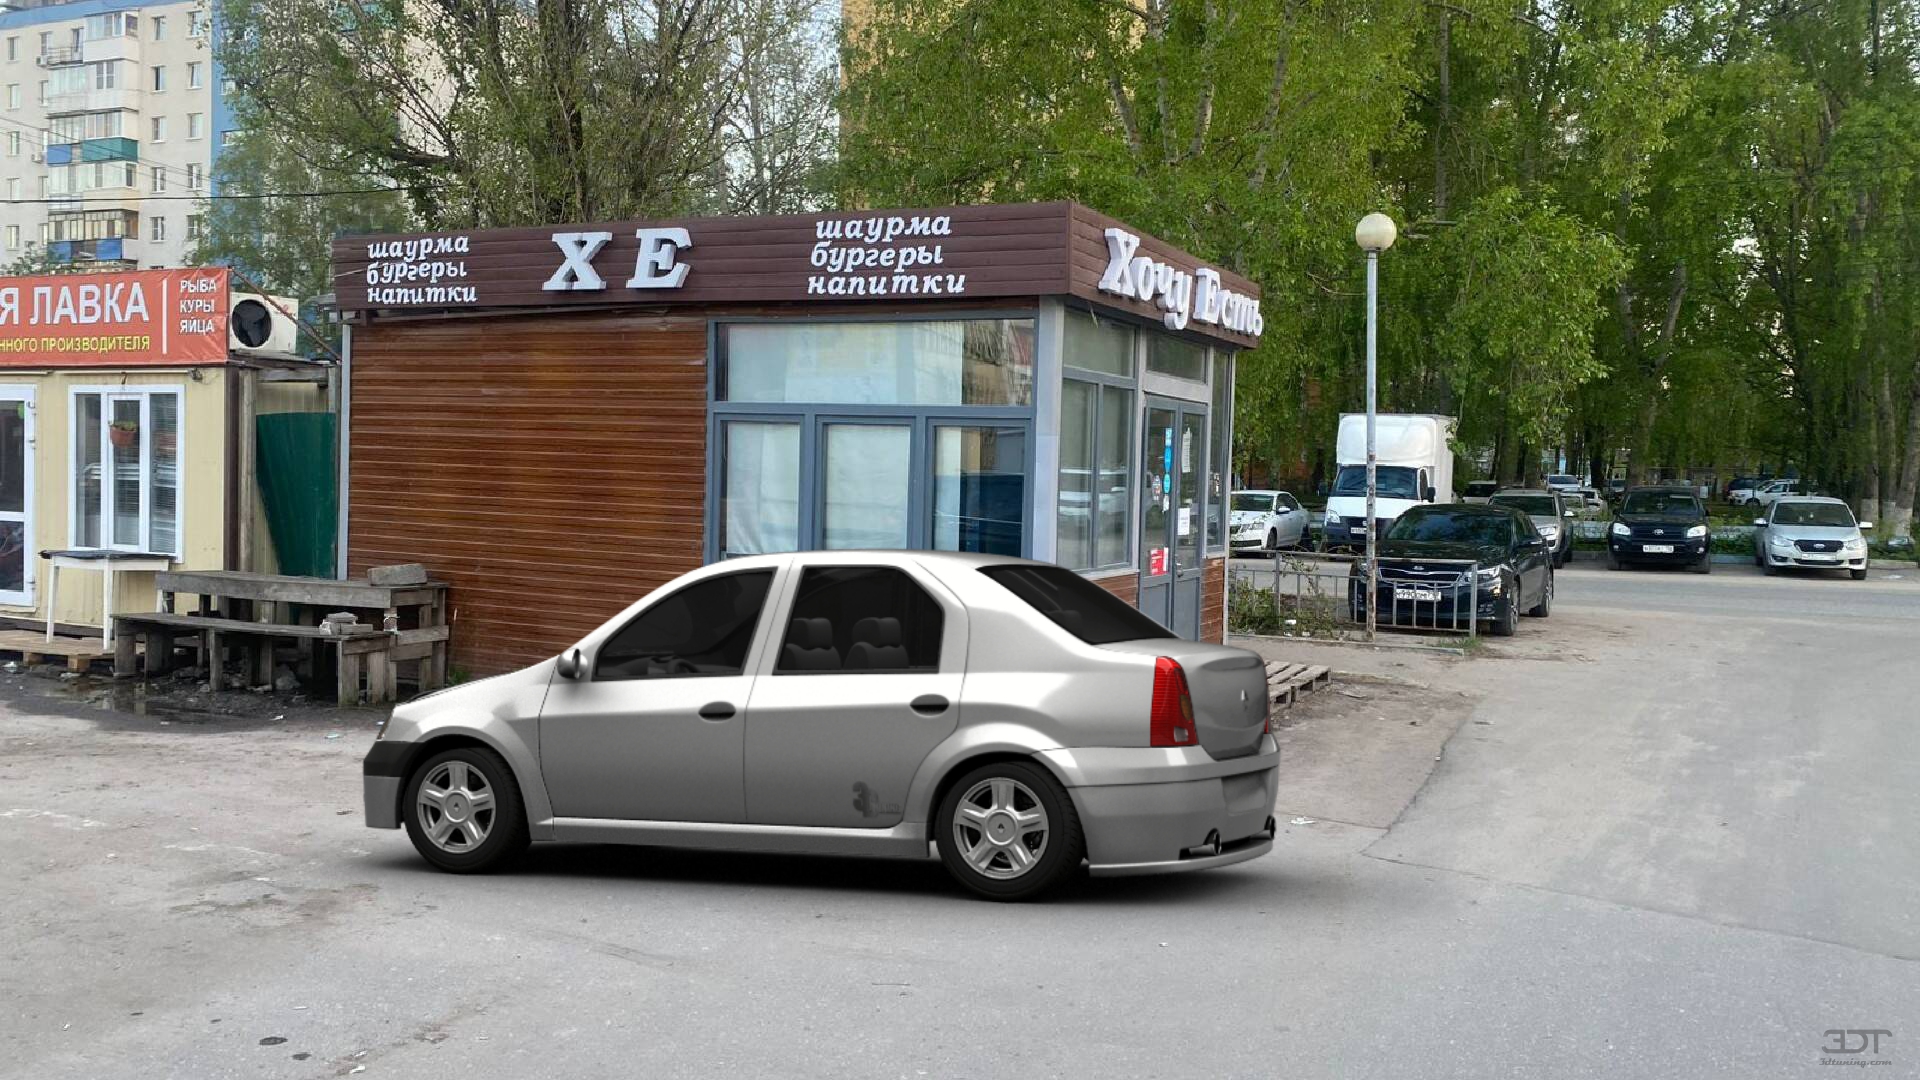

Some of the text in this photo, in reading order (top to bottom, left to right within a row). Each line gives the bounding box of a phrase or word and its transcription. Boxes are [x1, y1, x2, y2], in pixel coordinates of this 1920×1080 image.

[815, 215, 952, 243] шаурма
[366, 235, 470, 262] шаурма
[810, 240, 944, 273] бургеры
[366, 257, 468, 285] бургеры
[1097, 227, 1263, 337] Хочу Есть
[180, 279, 217, 293] РЫБА
[366, 284, 478, 304] напитки
[807, 273, 967, 296] напитки
[29, 282, 149, 325] ЛАВКА
[179, 299, 215, 314] КУРЫ
[179, 318, 214, 335] ЯЙЦА
[41, 335, 150, 352] ПРОИЗВОДИТЕЛЯ
